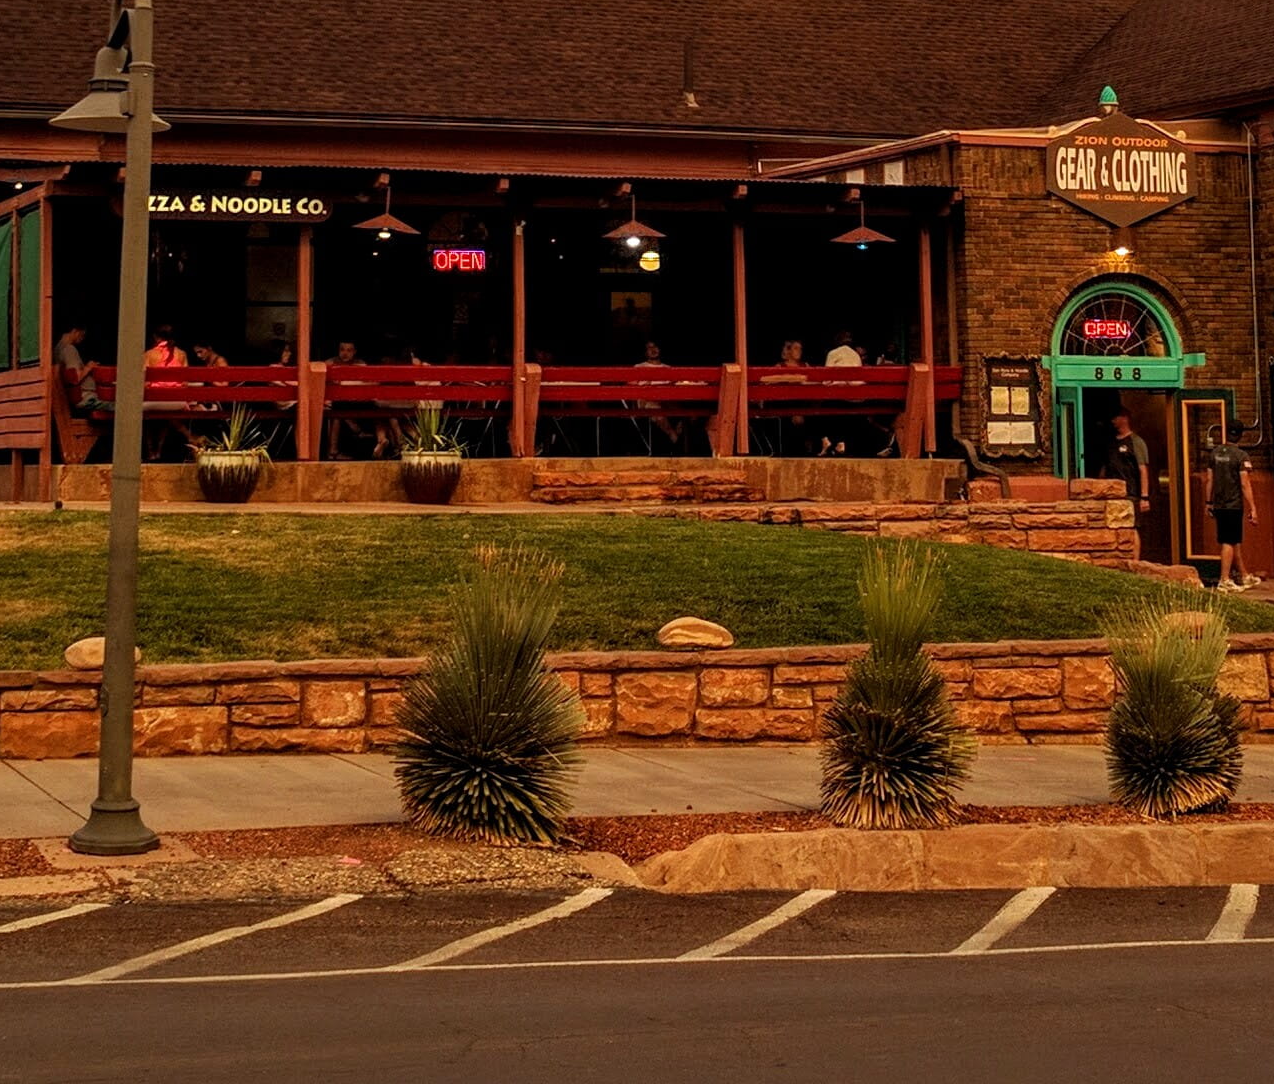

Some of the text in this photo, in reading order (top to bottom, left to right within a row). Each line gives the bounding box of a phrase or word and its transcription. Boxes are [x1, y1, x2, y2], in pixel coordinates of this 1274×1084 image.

[1074, 135, 1169, 147] ZION OUTDOOR
[1055, 146, 1188, 195] GEAR & CLOTHING
[189, 194, 206, 213] &
[211, 195, 292, 215] NOODLE
[295, 197, 328, 216] CO.
[435, 252, 484, 270] OPEN
[1084, 322, 1127, 336] OPEN
